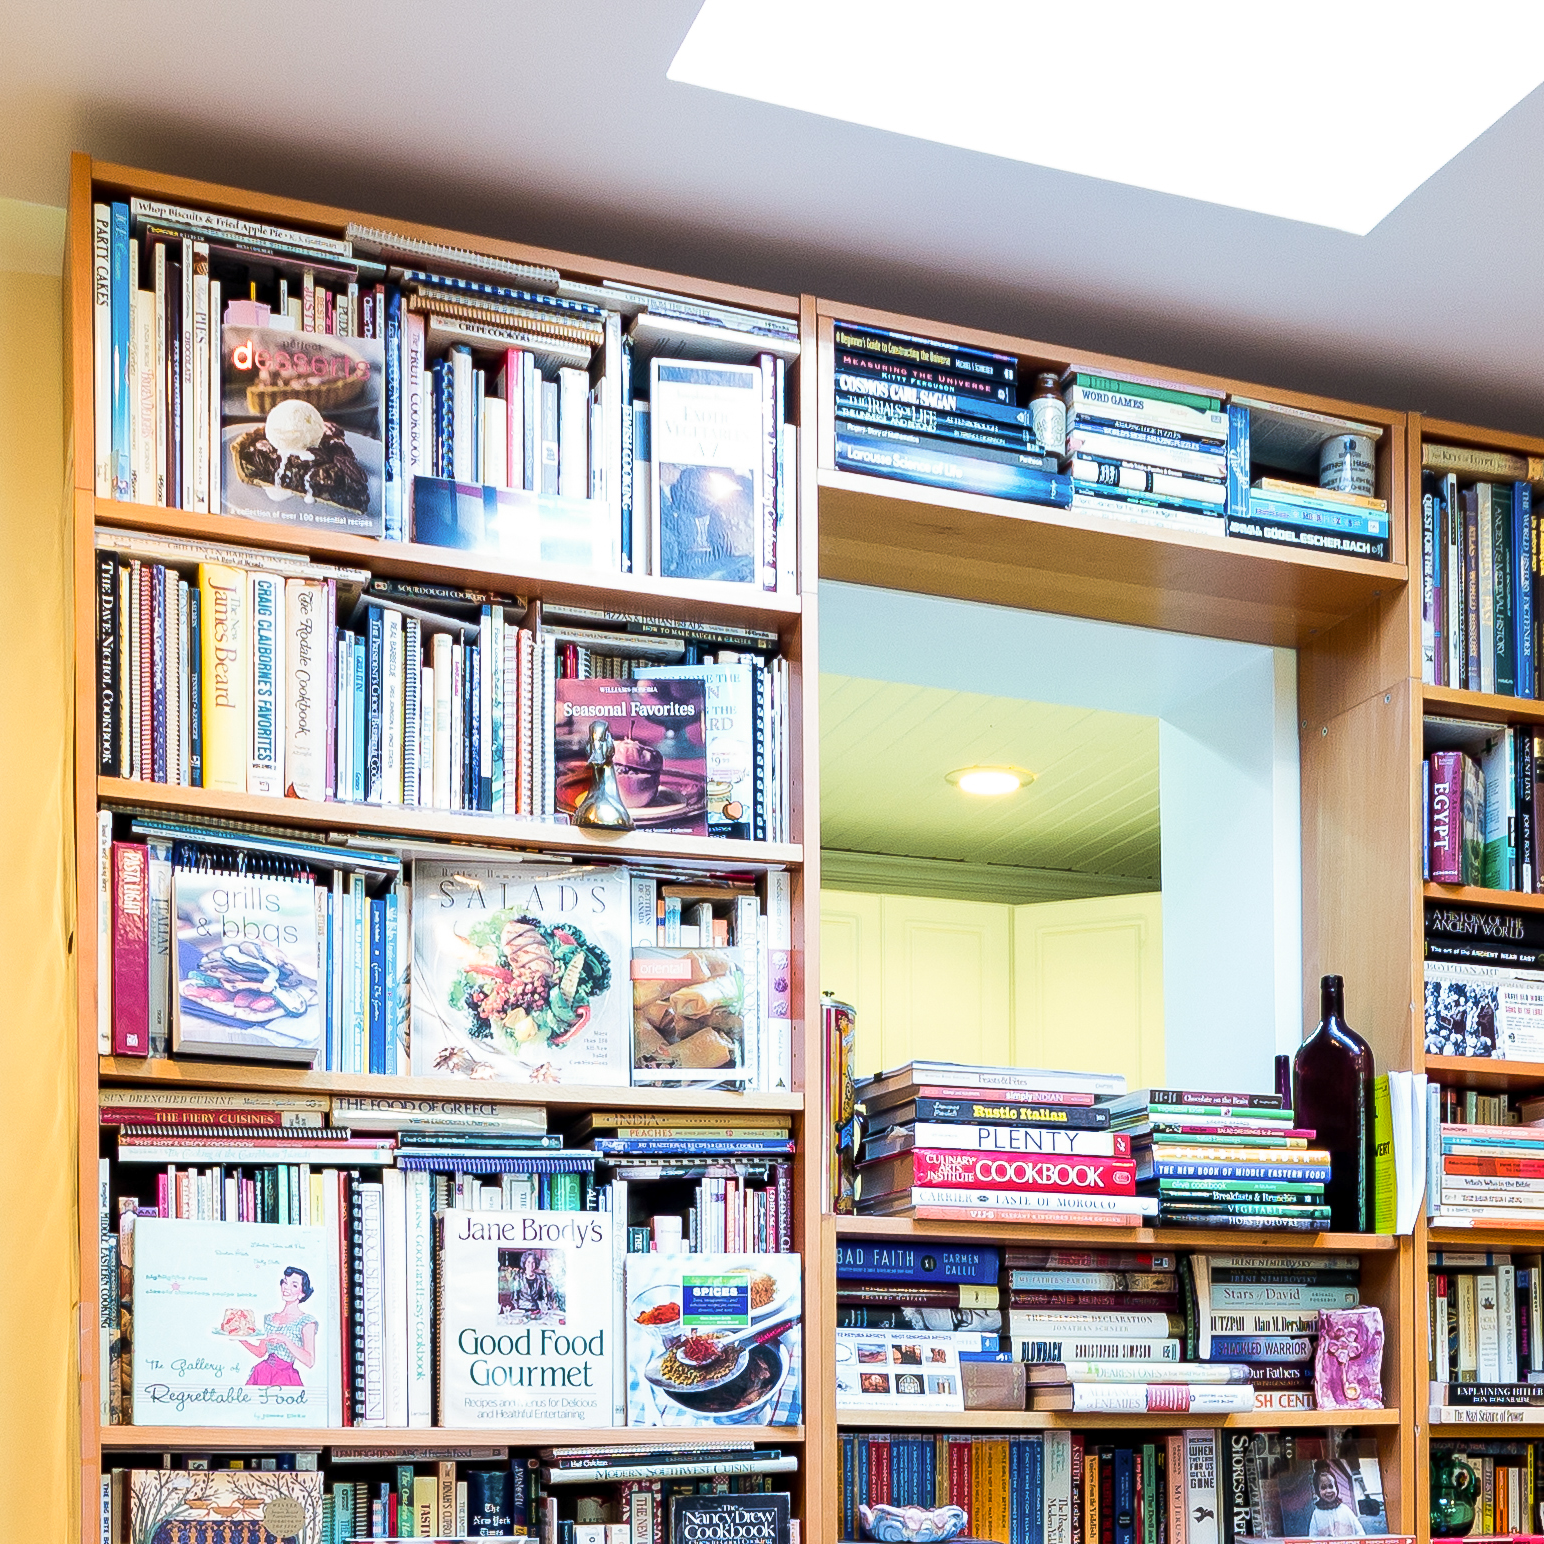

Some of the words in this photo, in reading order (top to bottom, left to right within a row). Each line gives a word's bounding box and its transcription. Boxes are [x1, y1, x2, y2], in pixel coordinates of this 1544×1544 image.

[232, 340, 372, 383] desserts
[101, 561, 114, 588] THE
[101, 592, 114, 633] DAVE
[257, 579, 272, 617] CRAIG
[257, 618, 272, 696] CLAIBORNE'S
[296, 619, 315, 666] Rodale
[101, 635, 114, 687] NICHOL
[294, 667, 309, 738] Cookbook
[563, 702, 626, 718] Seasonal
[631, 702, 695, 717] Favorites
[101, 690, 114, 764] COOKBOOK
[257, 698, 272, 762] FAVORITES
[1433, 782, 1450, 852] EGYPT
[212, 887, 281, 913] grills
[438, 880, 607, 914] SALADS
[196, 917, 212, 937] &
[222, 915, 299, 947] bbqs
[639, 962, 684, 975] oriental
[972, 1105, 1017, 1121] Rustic
[1018, 1107, 1068, 1122] Italian
[977, 1128, 1079, 1153] PLENTY
[975, 1160, 1105, 1188] COOKBOOK
[458, 1217, 515, 1241] Jane
[522, 1218, 604, 1248] Brody's
[836, 1249, 870, 1265] BAD
[875, 1250, 915, 1266] FAITH
[458, 1328, 531, 1356] Good
[541, 1329, 605, 1356] Food
[170, 1358, 225, 1378] Gallery
[469, 1359, 594, 1388] Gourmet
[144, 1383, 252, 1412] Regrettable
[258, 1385, 309, 1406] Food
[684, 1523, 775, 1540] Cookbook
[685, 1510, 733, 1528] Nancy
[735, 1509, 773, 1525] Drew
